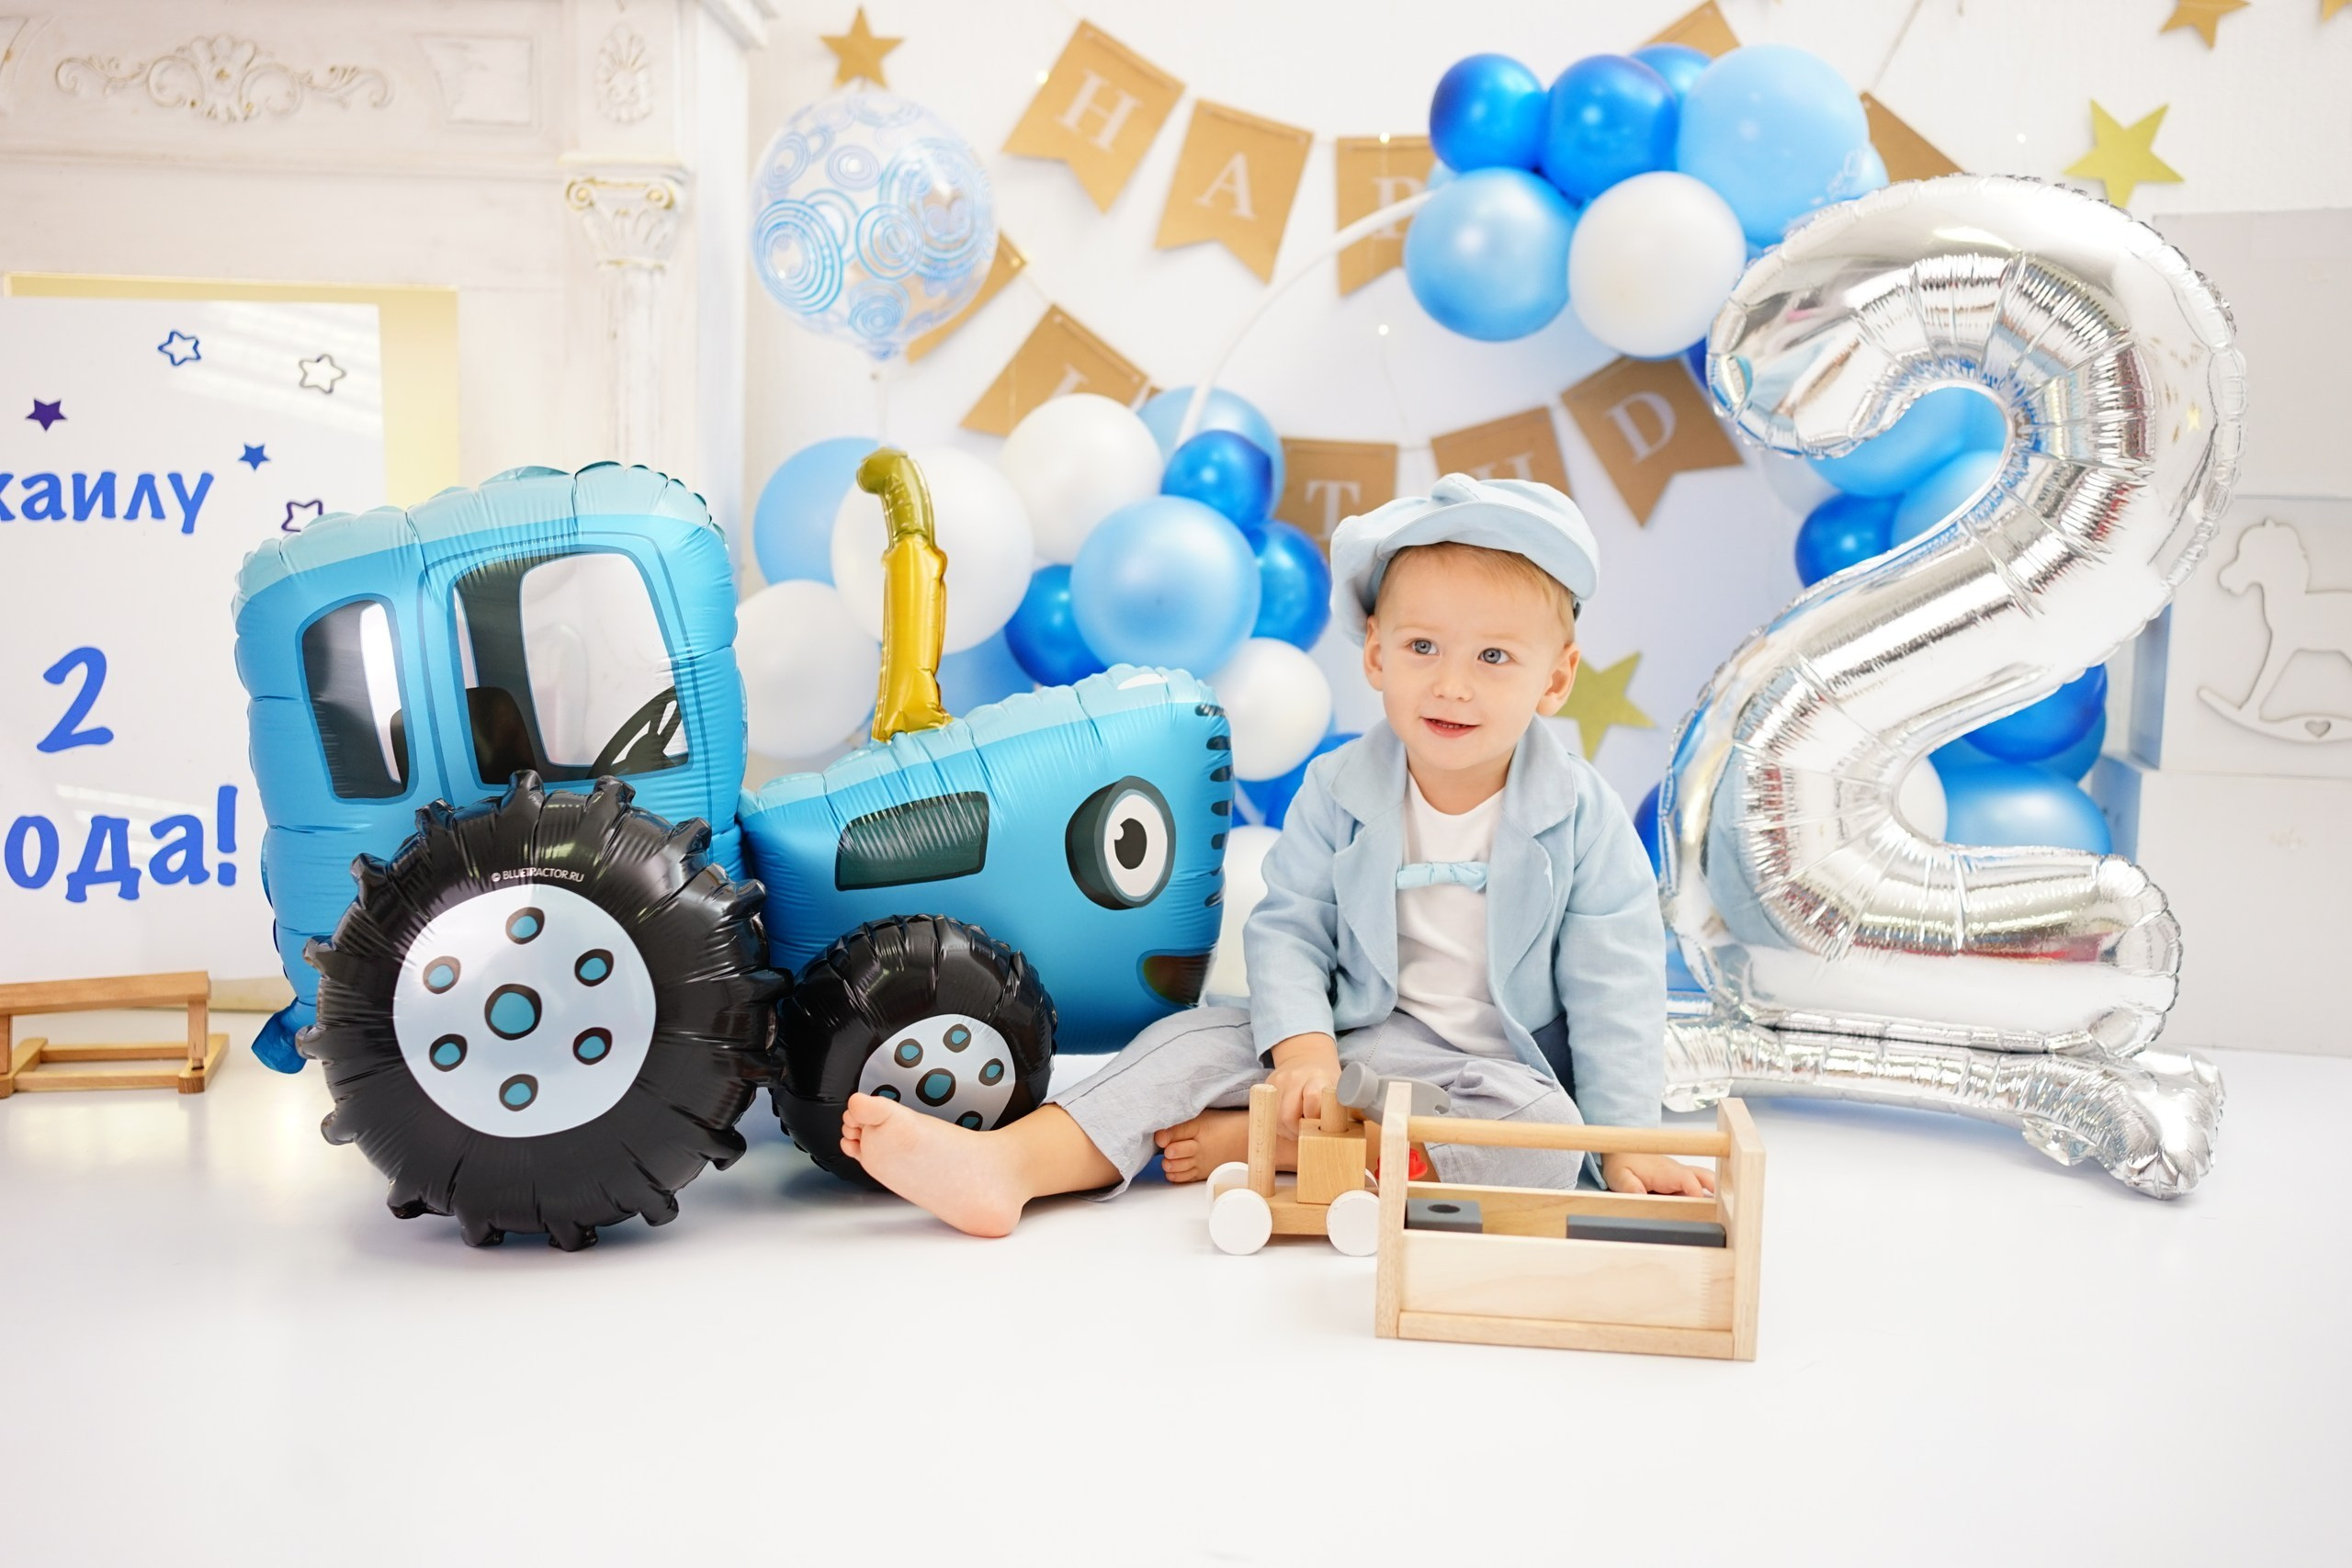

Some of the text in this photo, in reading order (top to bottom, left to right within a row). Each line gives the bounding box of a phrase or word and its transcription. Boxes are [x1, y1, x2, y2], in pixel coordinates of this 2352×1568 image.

[36, 646, 114, 753] 2
[4, 784, 238, 902] ода!
[503, 867, 584, 883] BLUETRACTOR.RU
